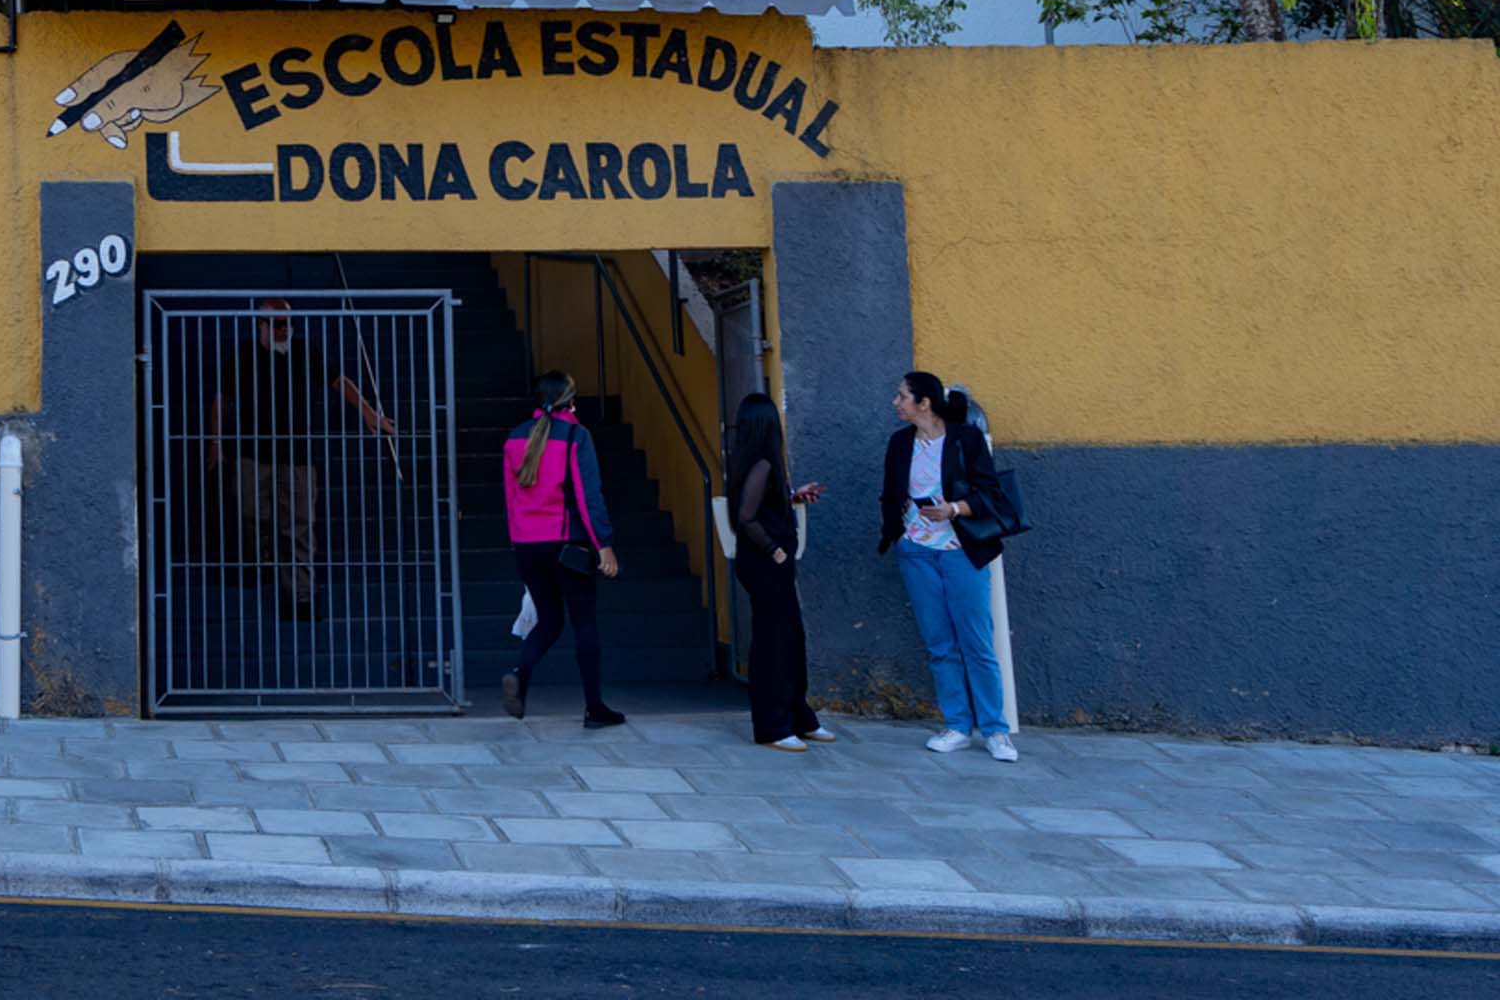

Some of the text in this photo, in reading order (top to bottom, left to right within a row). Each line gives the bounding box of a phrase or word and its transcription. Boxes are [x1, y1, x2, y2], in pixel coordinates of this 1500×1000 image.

[221, 18, 841, 158] ESCOLA ESTADUAL
[277, 141, 754, 201] DONA CAROLA
[46, 235, 128, 305] 290
